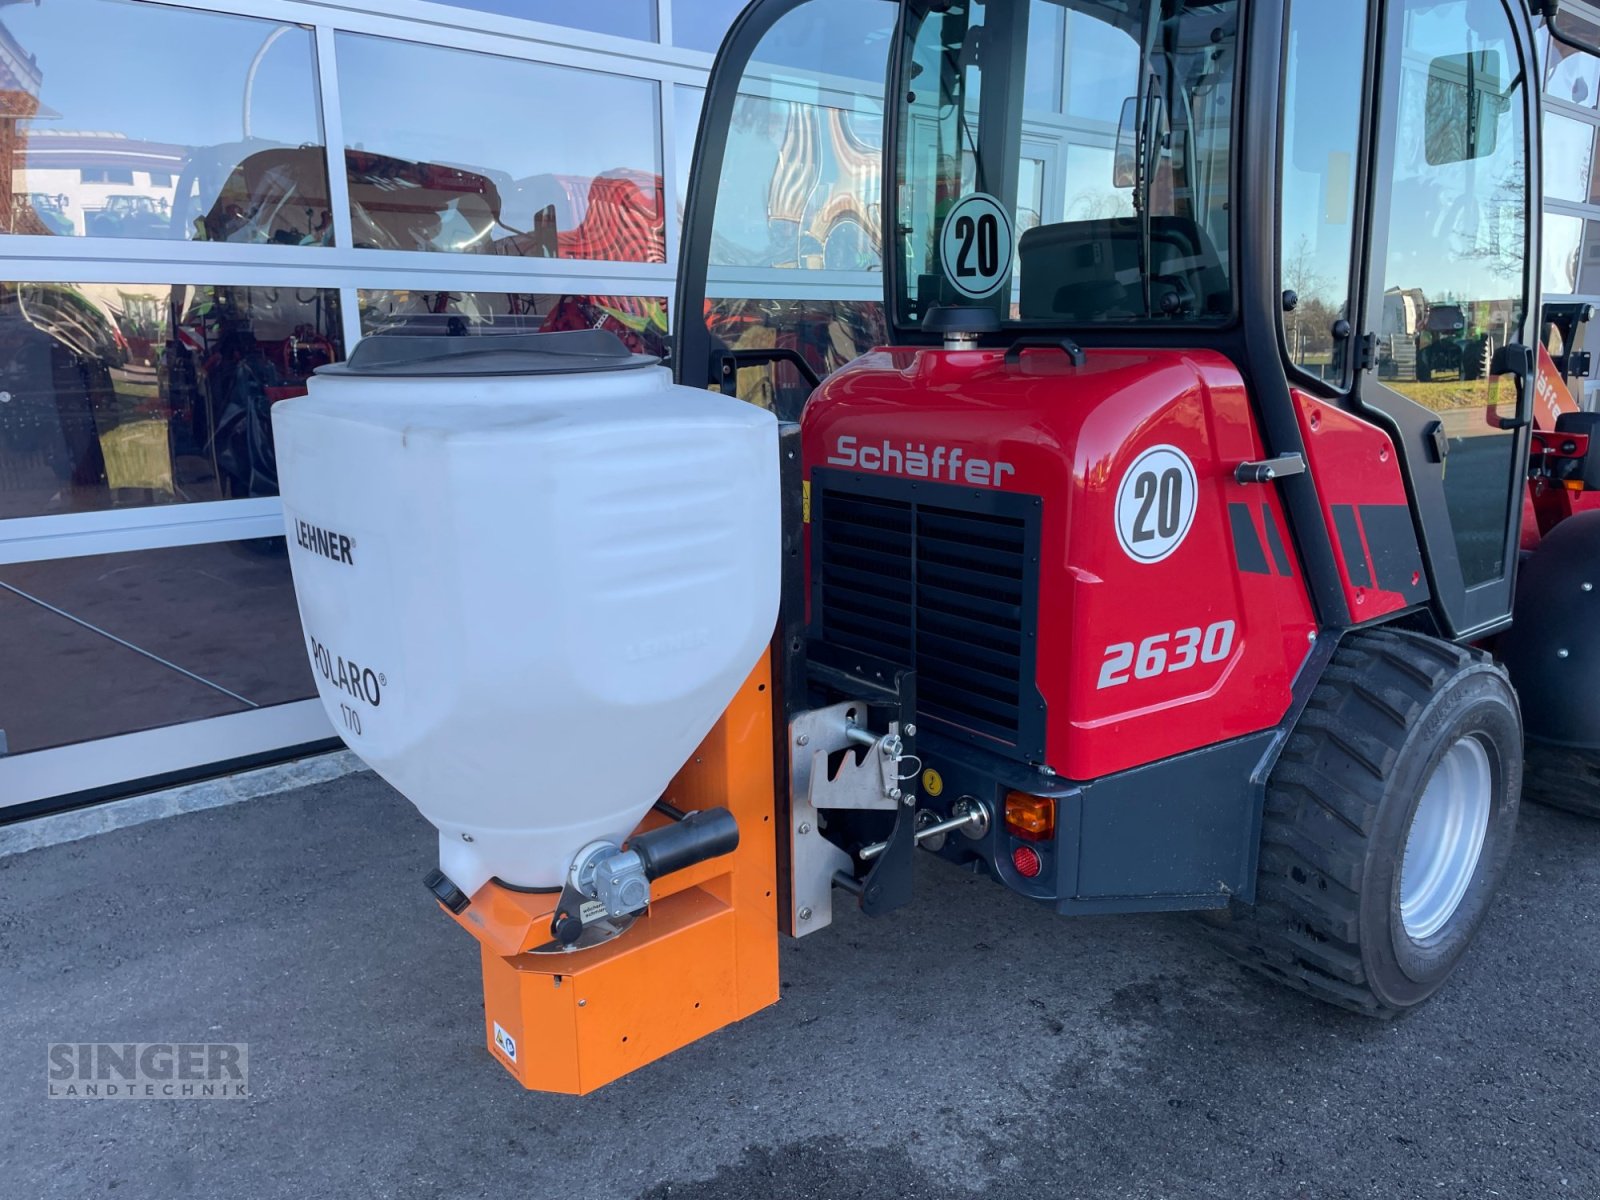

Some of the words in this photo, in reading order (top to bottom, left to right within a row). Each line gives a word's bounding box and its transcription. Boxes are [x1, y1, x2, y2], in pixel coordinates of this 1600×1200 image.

[955, 213, 998, 277] 20
[827, 435, 1015, 487] Schäffer
[1132, 467, 1182, 543] 20
[1096, 619, 1236, 690] 2630
[340, 703, 362, 736] 170
